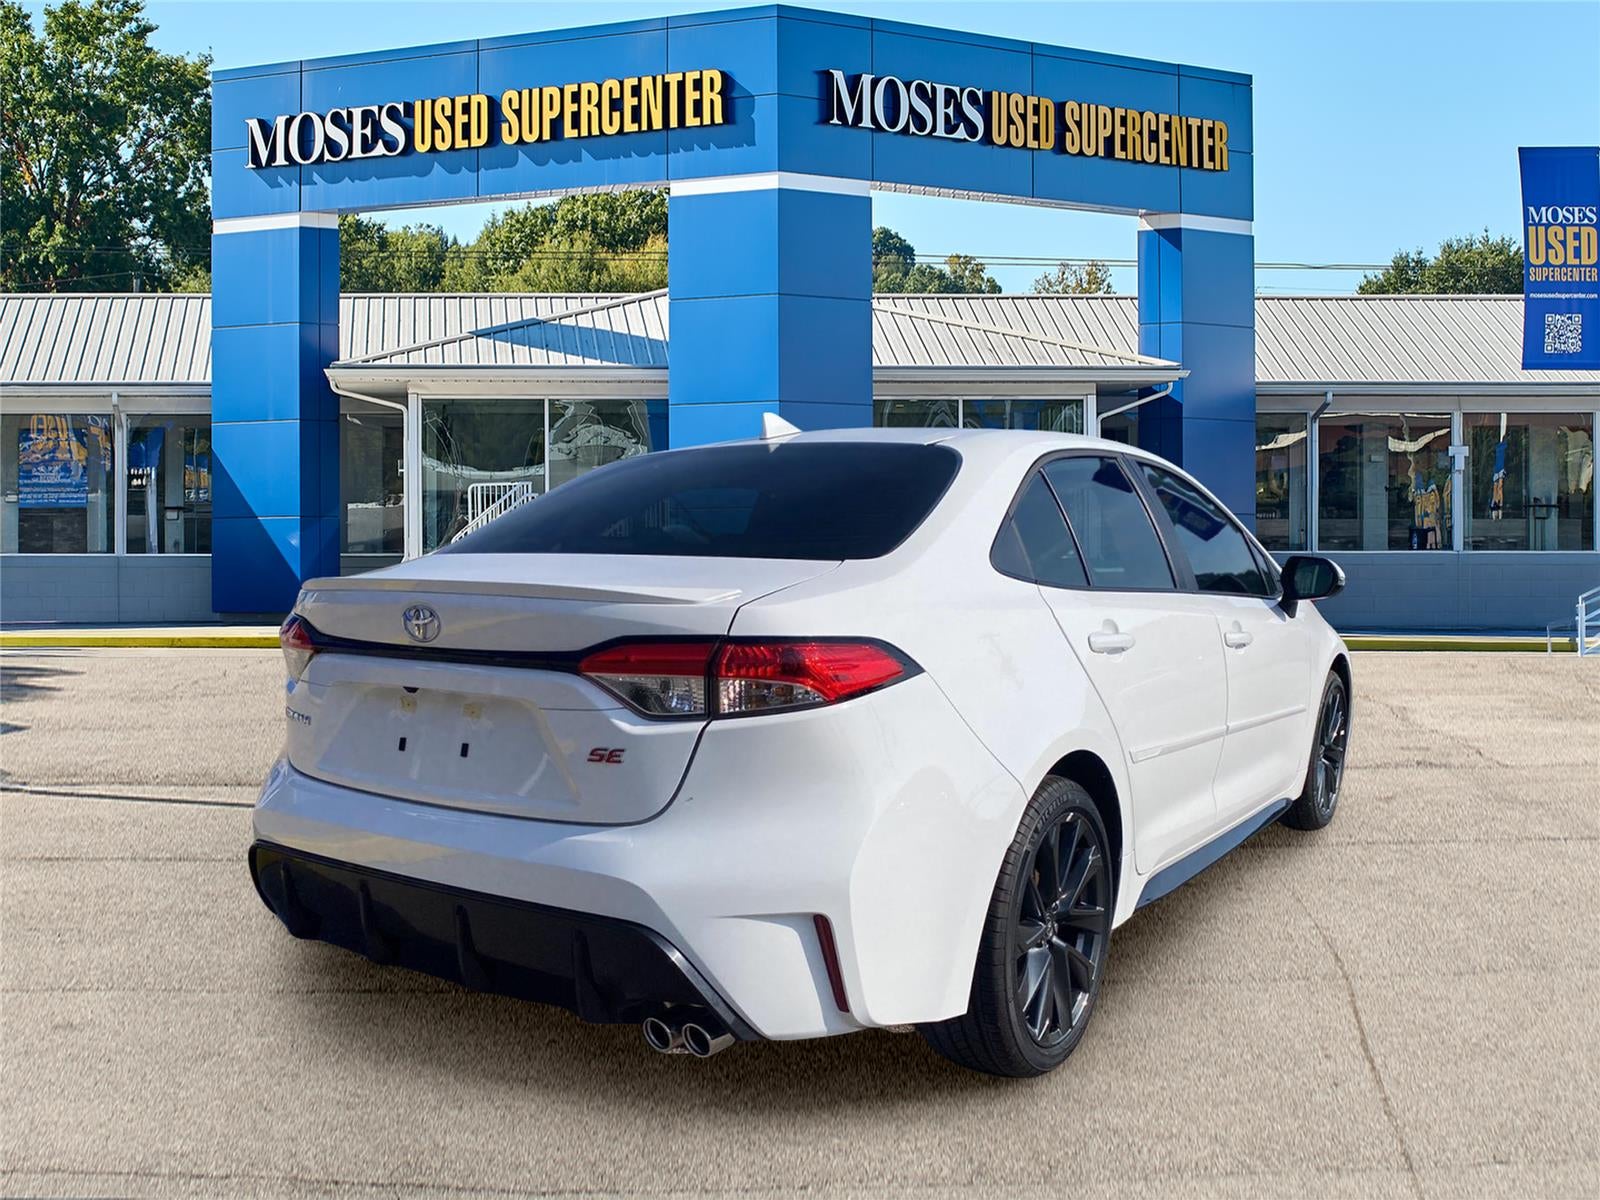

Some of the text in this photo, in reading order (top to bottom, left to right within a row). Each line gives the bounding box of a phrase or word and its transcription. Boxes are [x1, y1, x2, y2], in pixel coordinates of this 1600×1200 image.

[244, 69, 724, 169] MOSES USED SUPERCENTER
[828, 69, 1230, 171] MOSES USED SUPERCENTER
[1527, 206, 1597, 224] MOSES
[1528, 226, 1598, 265] USED
[1529, 267, 1598, 282] SUPERCENTER
[587, 748, 625, 763] SE
